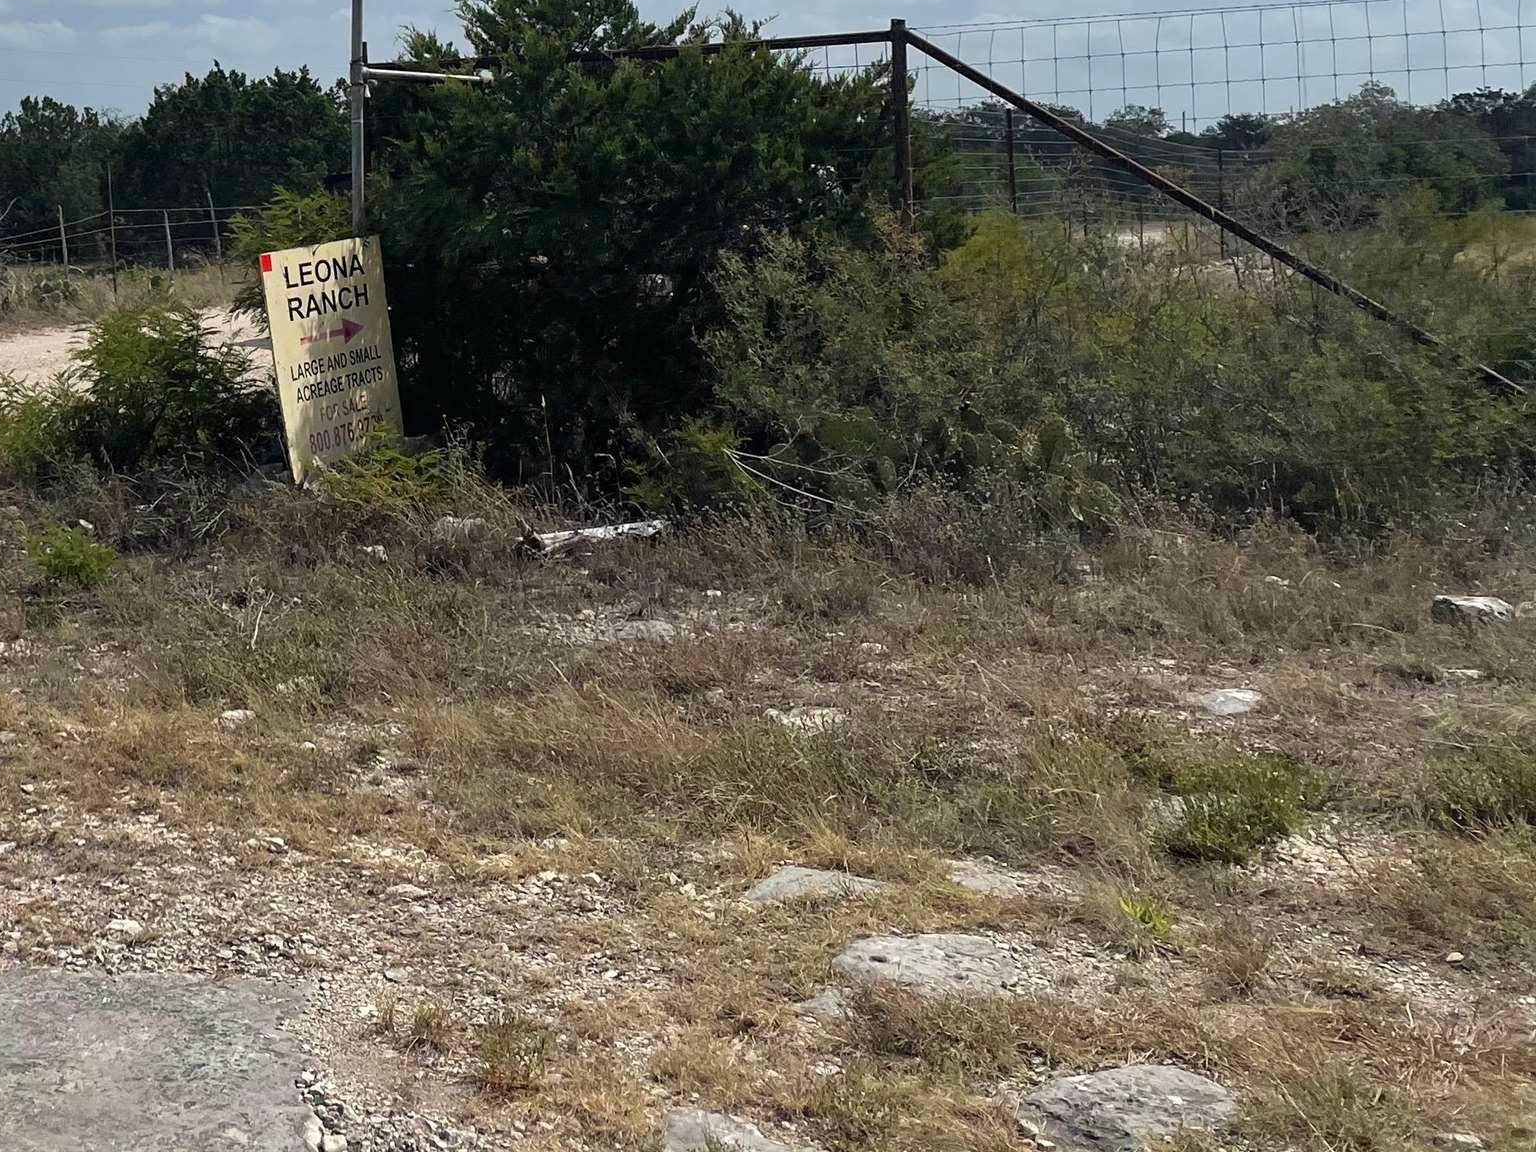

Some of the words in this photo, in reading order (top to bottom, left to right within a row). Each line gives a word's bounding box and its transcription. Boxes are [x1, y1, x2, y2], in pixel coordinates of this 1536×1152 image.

[283, 254, 365, 289] LEONA
[287, 283, 369, 321] RANCH
[290, 358, 325, 381] LARGE
[327, 352, 347, 371] AND
[349, 345, 382, 366] SMALL
[297, 376, 344, 403] ACREAGE
[345, 366, 383, 389] TRACTS
[320, 404, 341, 423] FOR
[343, 394, 368, 416] SALE
